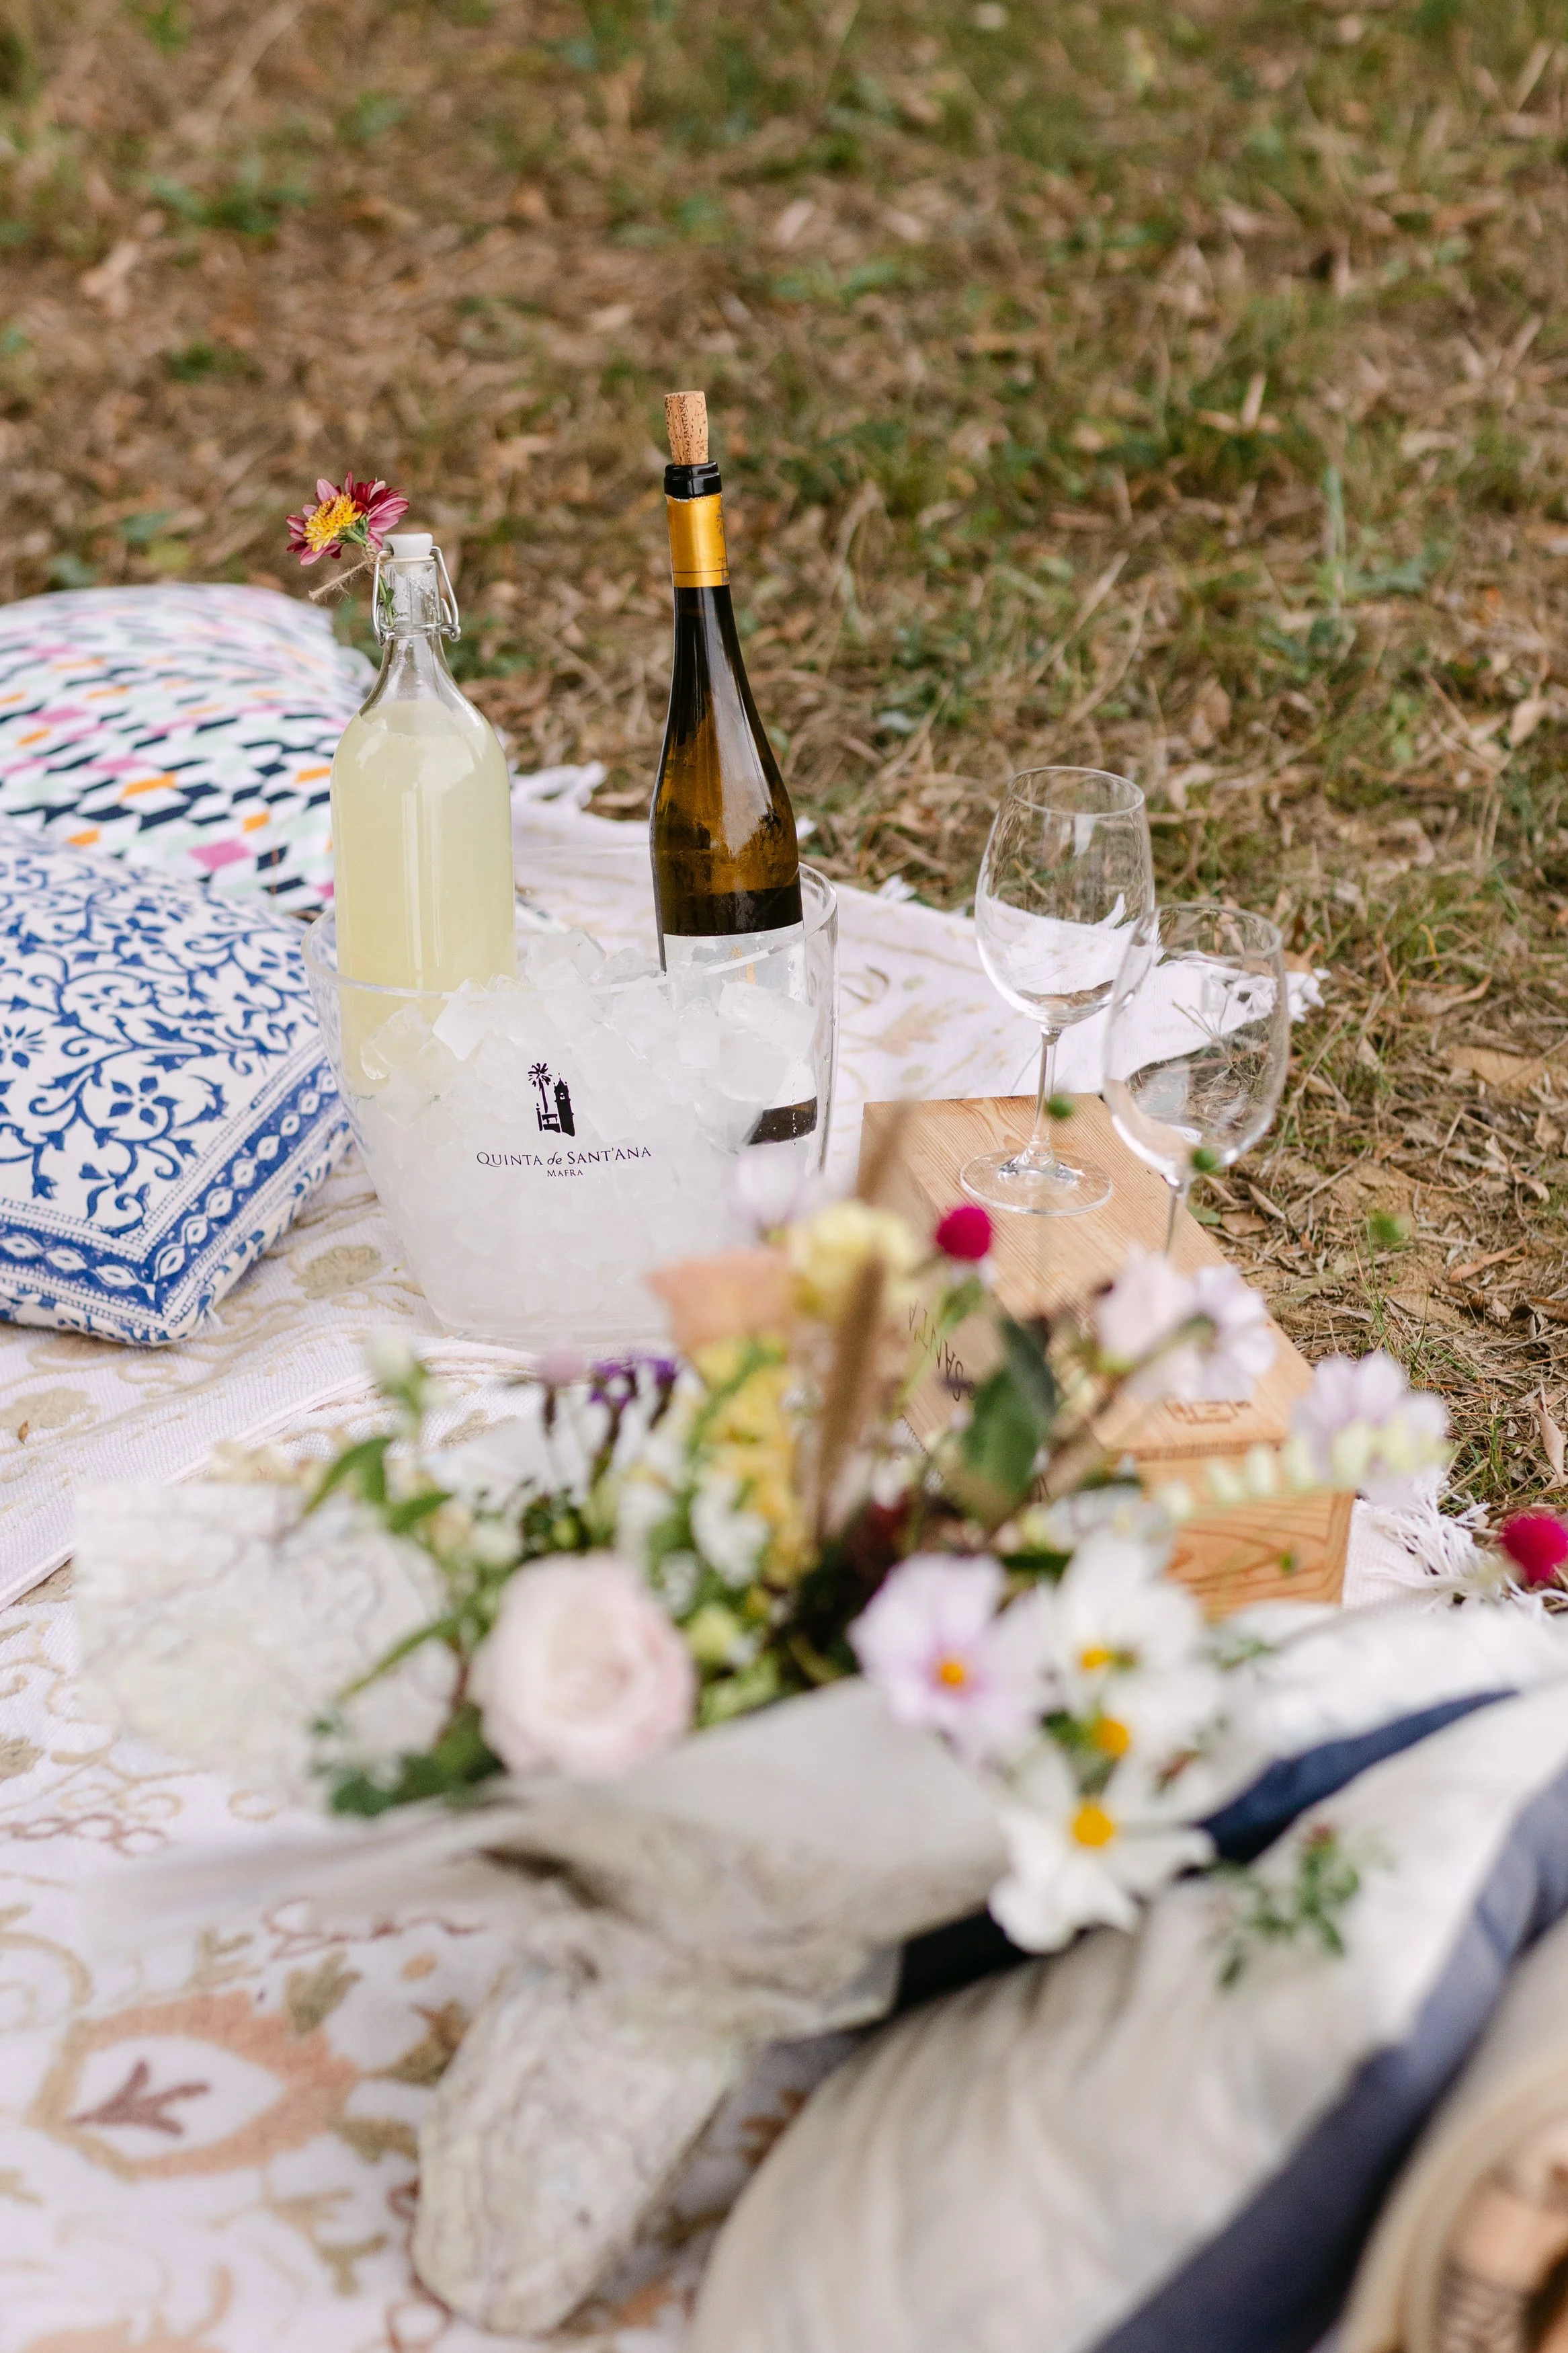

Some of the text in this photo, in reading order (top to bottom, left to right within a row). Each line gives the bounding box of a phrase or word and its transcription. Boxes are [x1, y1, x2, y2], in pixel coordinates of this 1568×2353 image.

[477, 1146, 651, 1167] QUINTA de SANT'ANA
[547, 1168, 583, 1176] MAFRA
